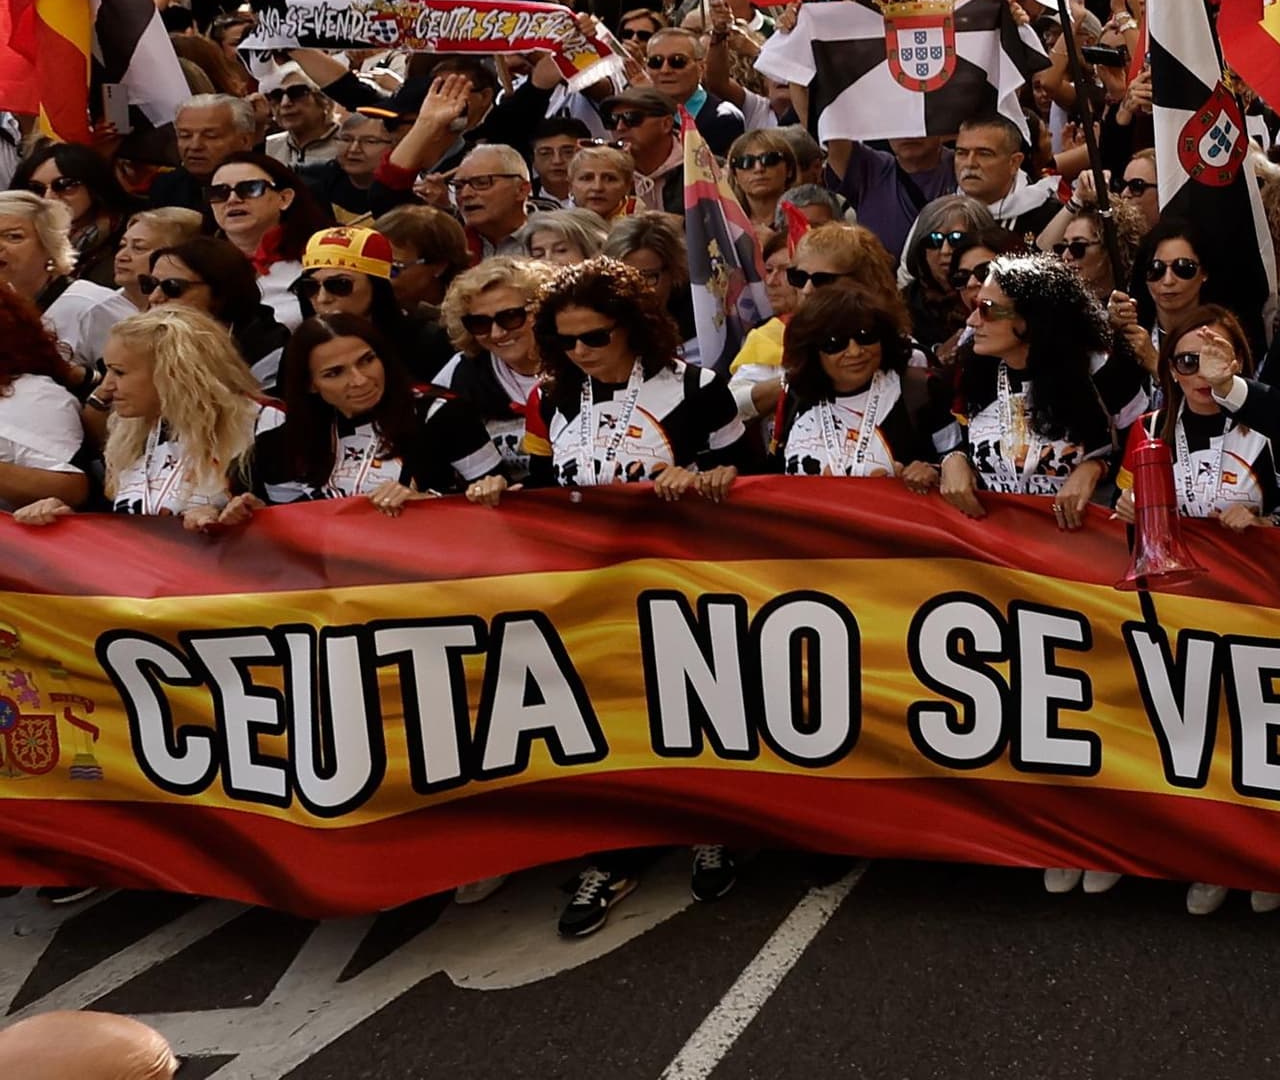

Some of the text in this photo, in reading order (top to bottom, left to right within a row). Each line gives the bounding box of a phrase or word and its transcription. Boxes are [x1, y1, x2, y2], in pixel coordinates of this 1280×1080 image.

[98, 612, 606, 815] CEUTA
[638, 590, 859, 766] NO
[908, 592, 1100, 775] SE
